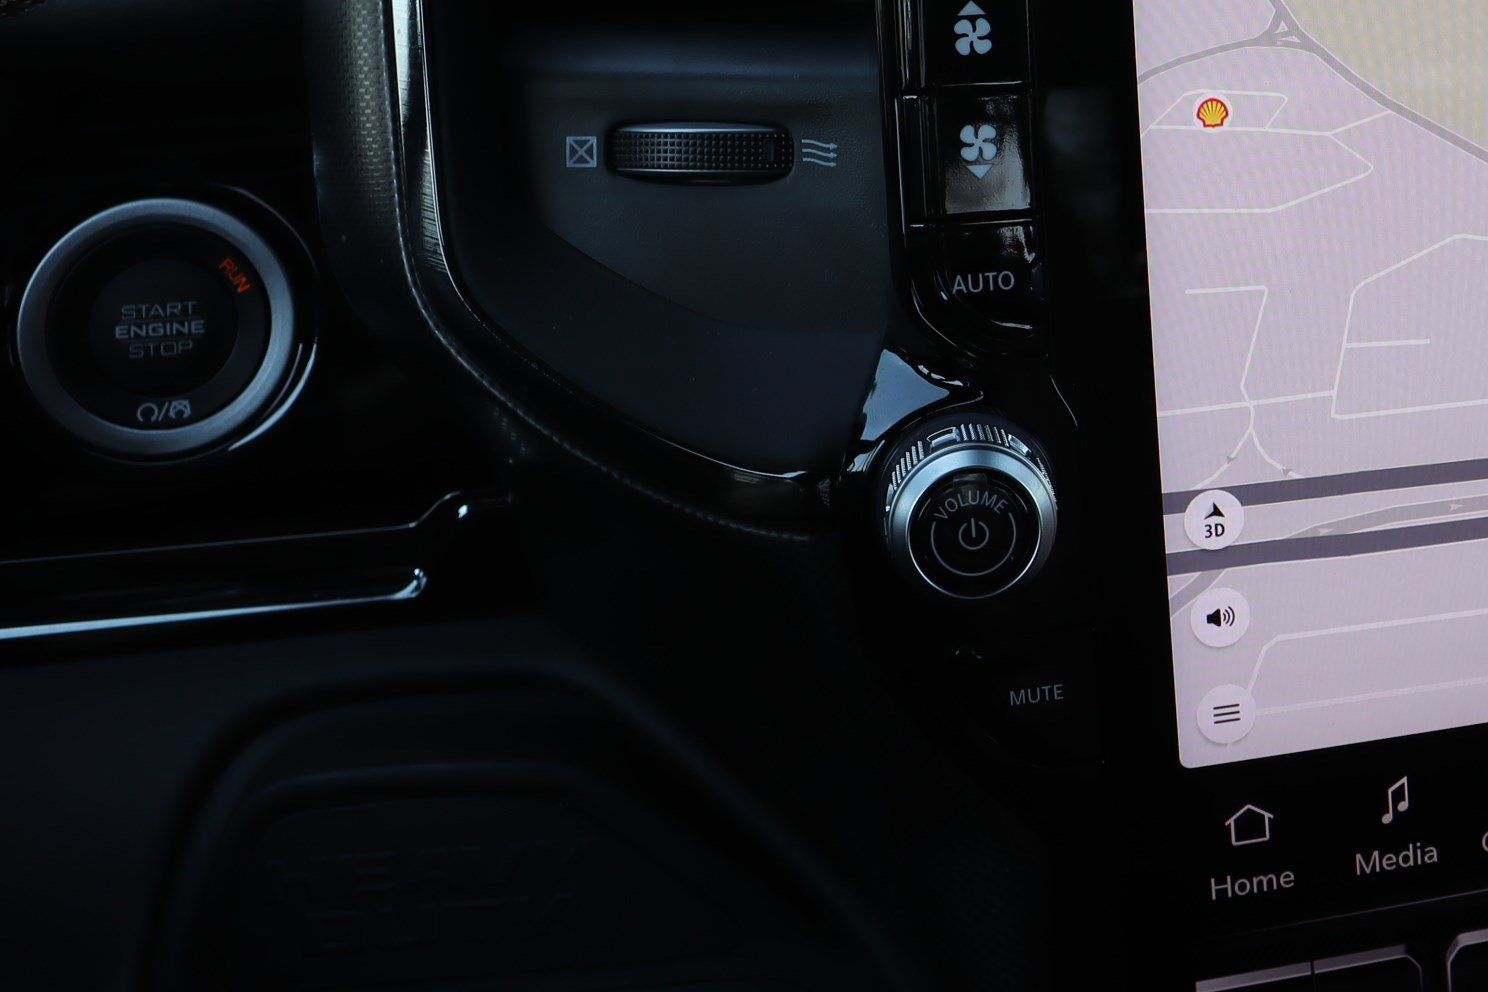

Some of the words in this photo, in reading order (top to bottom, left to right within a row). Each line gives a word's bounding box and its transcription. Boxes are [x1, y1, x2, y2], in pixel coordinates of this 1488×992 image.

[218, 257, 251, 294] RUN
[951, 270, 1016, 295] AUTO
[120, 300, 199, 320] START
[114, 319, 206, 340] ENGINE
[128, 339, 194, 358] STOP
[935, 489, 1009, 521] VOLUME
[1203, 521, 1227, 540] 3D
[1008, 682, 1066, 708] MUTE
[1354, 842, 1439, 877] Media
[1209, 868, 1296, 901] Home
